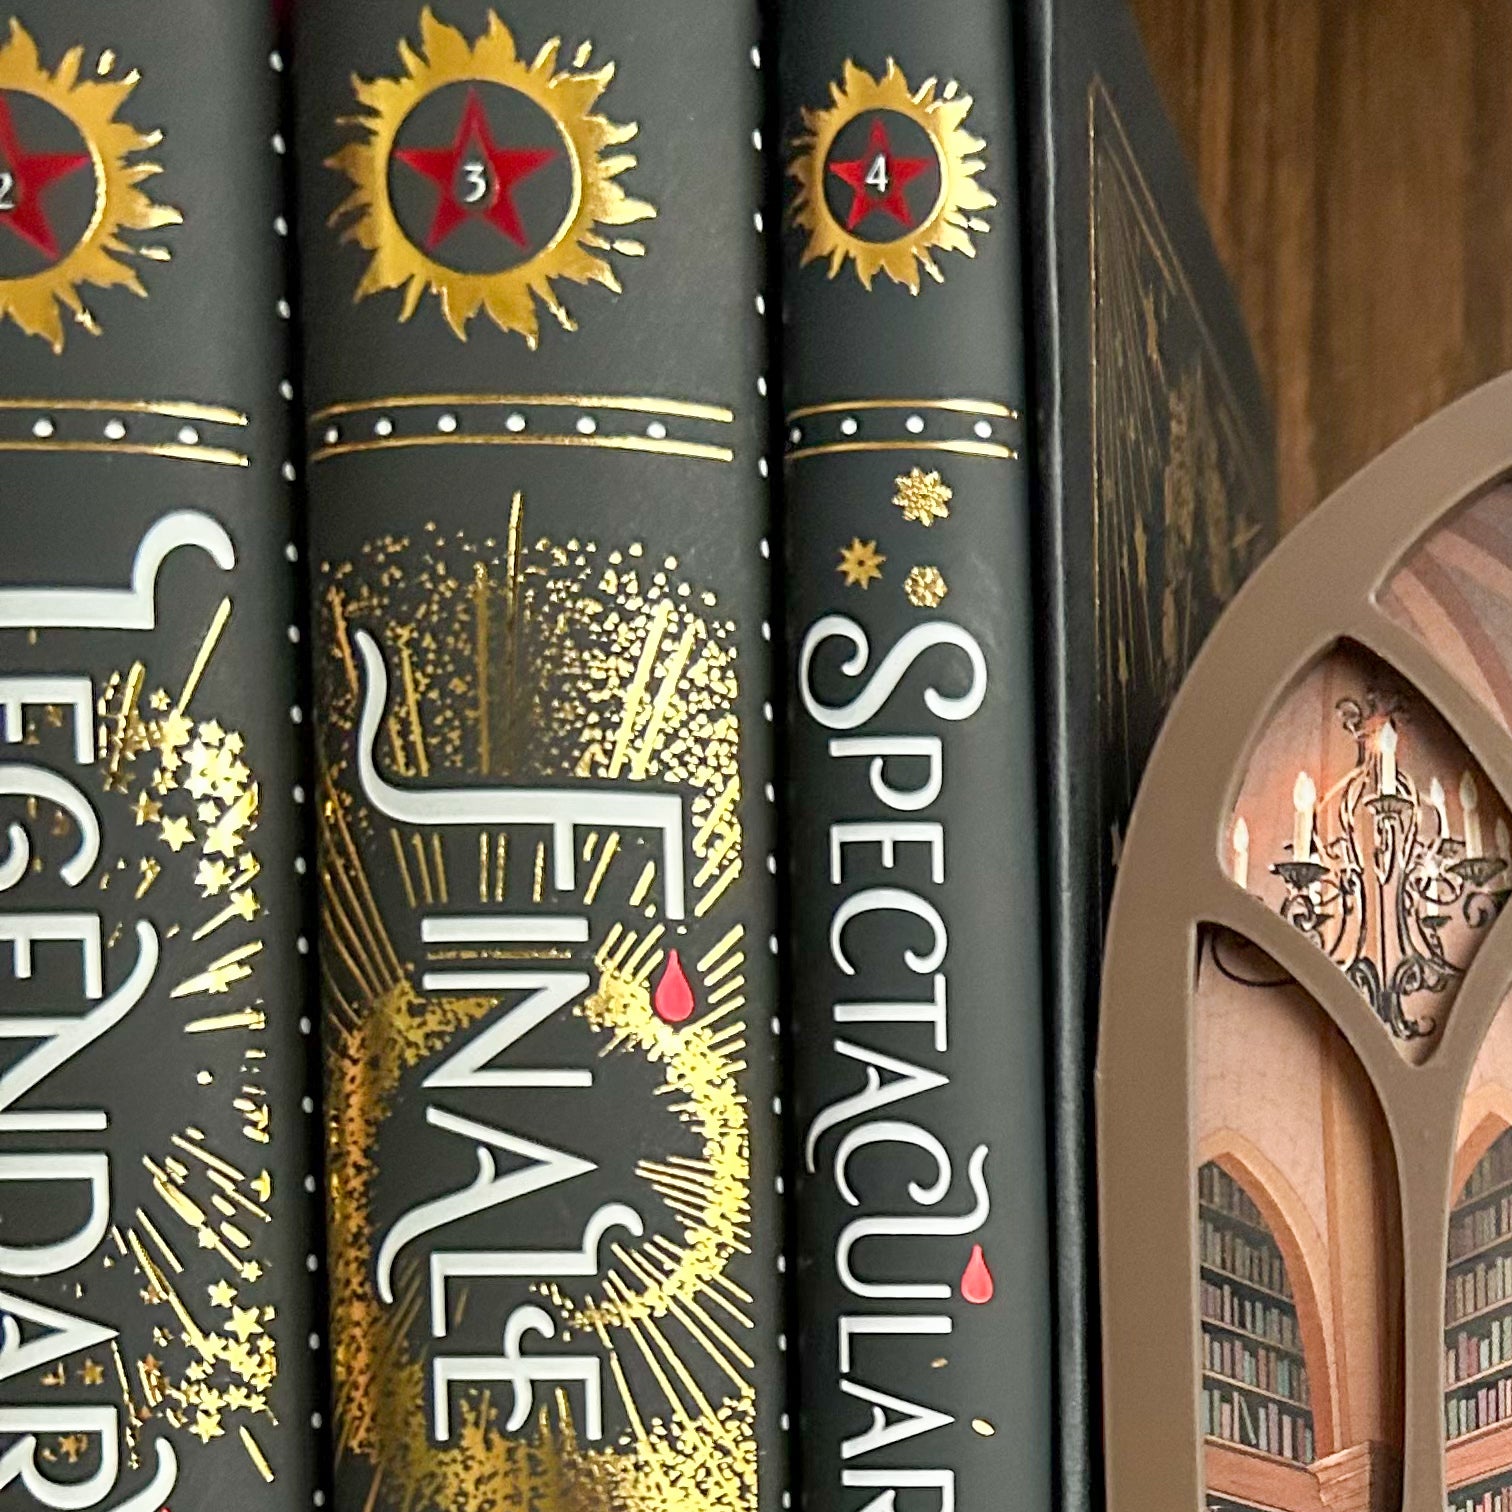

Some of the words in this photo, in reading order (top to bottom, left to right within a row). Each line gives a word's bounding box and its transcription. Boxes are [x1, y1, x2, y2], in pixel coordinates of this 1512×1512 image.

[464, 162, 487, 202] 3
[865, 154, 889, 192] 4
[354, 628, 685, 1443] FINALE
